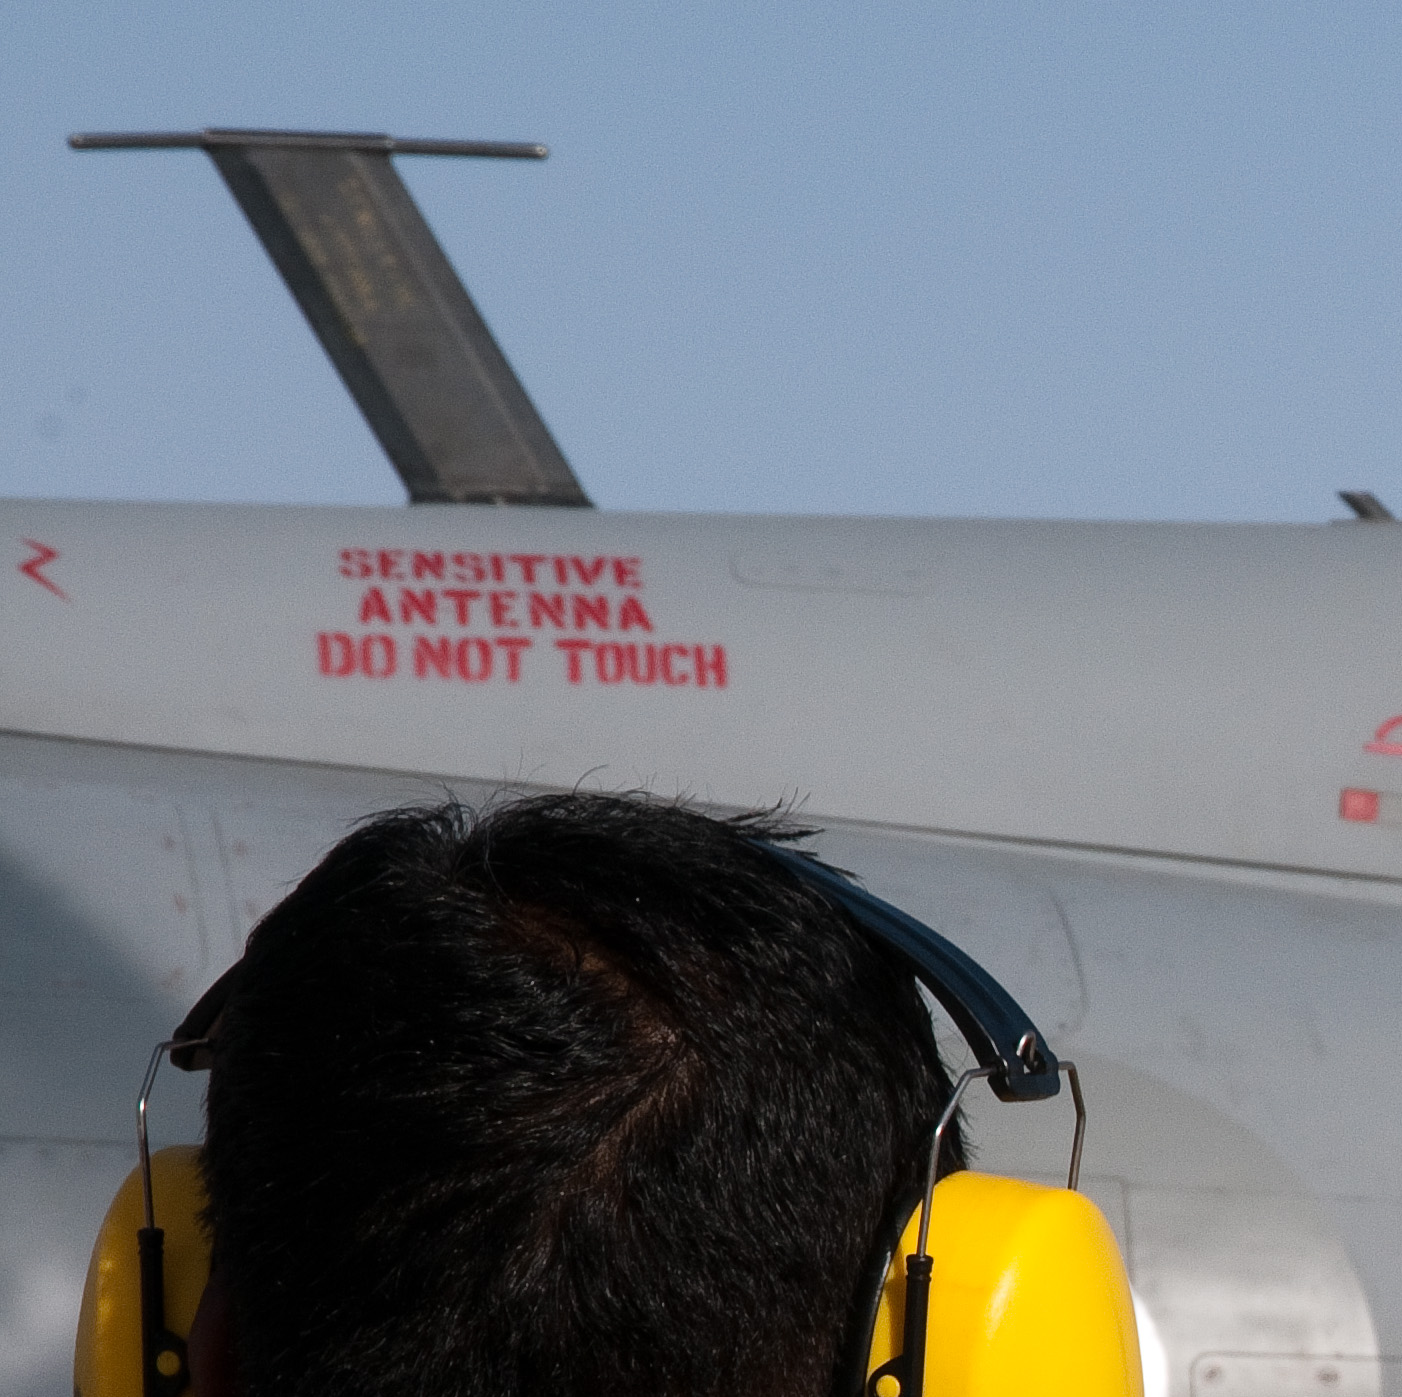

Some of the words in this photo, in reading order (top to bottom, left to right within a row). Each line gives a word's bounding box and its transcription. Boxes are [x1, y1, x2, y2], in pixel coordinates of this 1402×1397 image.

[339, 549, 643, 589] SENSITIVE
[359, 586, 653, 632] ANTENNA
[317, 631, 397, 678] DO
[413, 634, 533, 683] NOT
[554, 638, 728, 689] TOUCH
